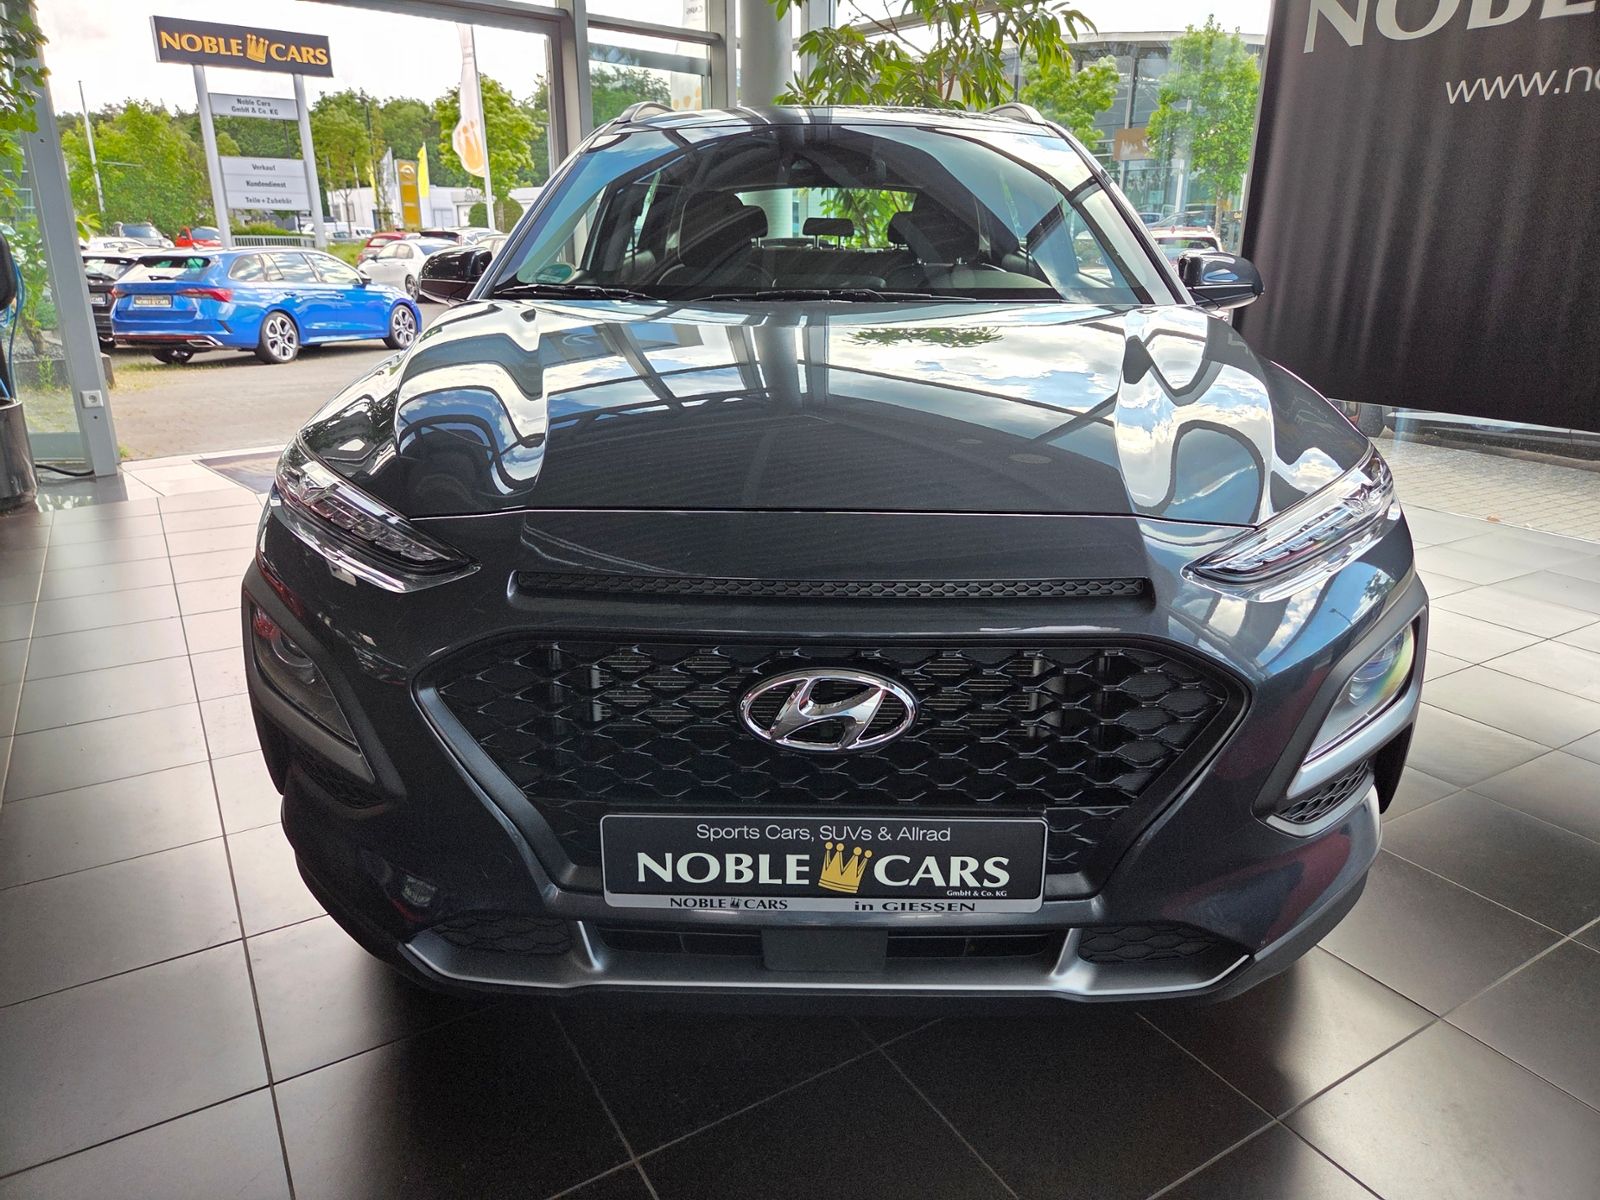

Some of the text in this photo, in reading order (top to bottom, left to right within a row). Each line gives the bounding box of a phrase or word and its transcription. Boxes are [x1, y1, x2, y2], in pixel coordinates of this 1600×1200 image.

[1304, 0, 1597, 53] NO
[160, 31, 329, 65] NOBLE CARS
[237, 98, 254, 106] Noble
[231, 105, 250, 113] GmbH
[252, 163, 276, 171] Verkauf
[246, 180, 287, 188] Kundendienst
[696, 824, 951, 842] Sports Cars, SUVs & Allrad
[637, 852, 1011, 888] NOBLE CARS
[670, 897, 788, 910] NOBLE CARS
[854, 901, 976, 912] in GIESSEN
